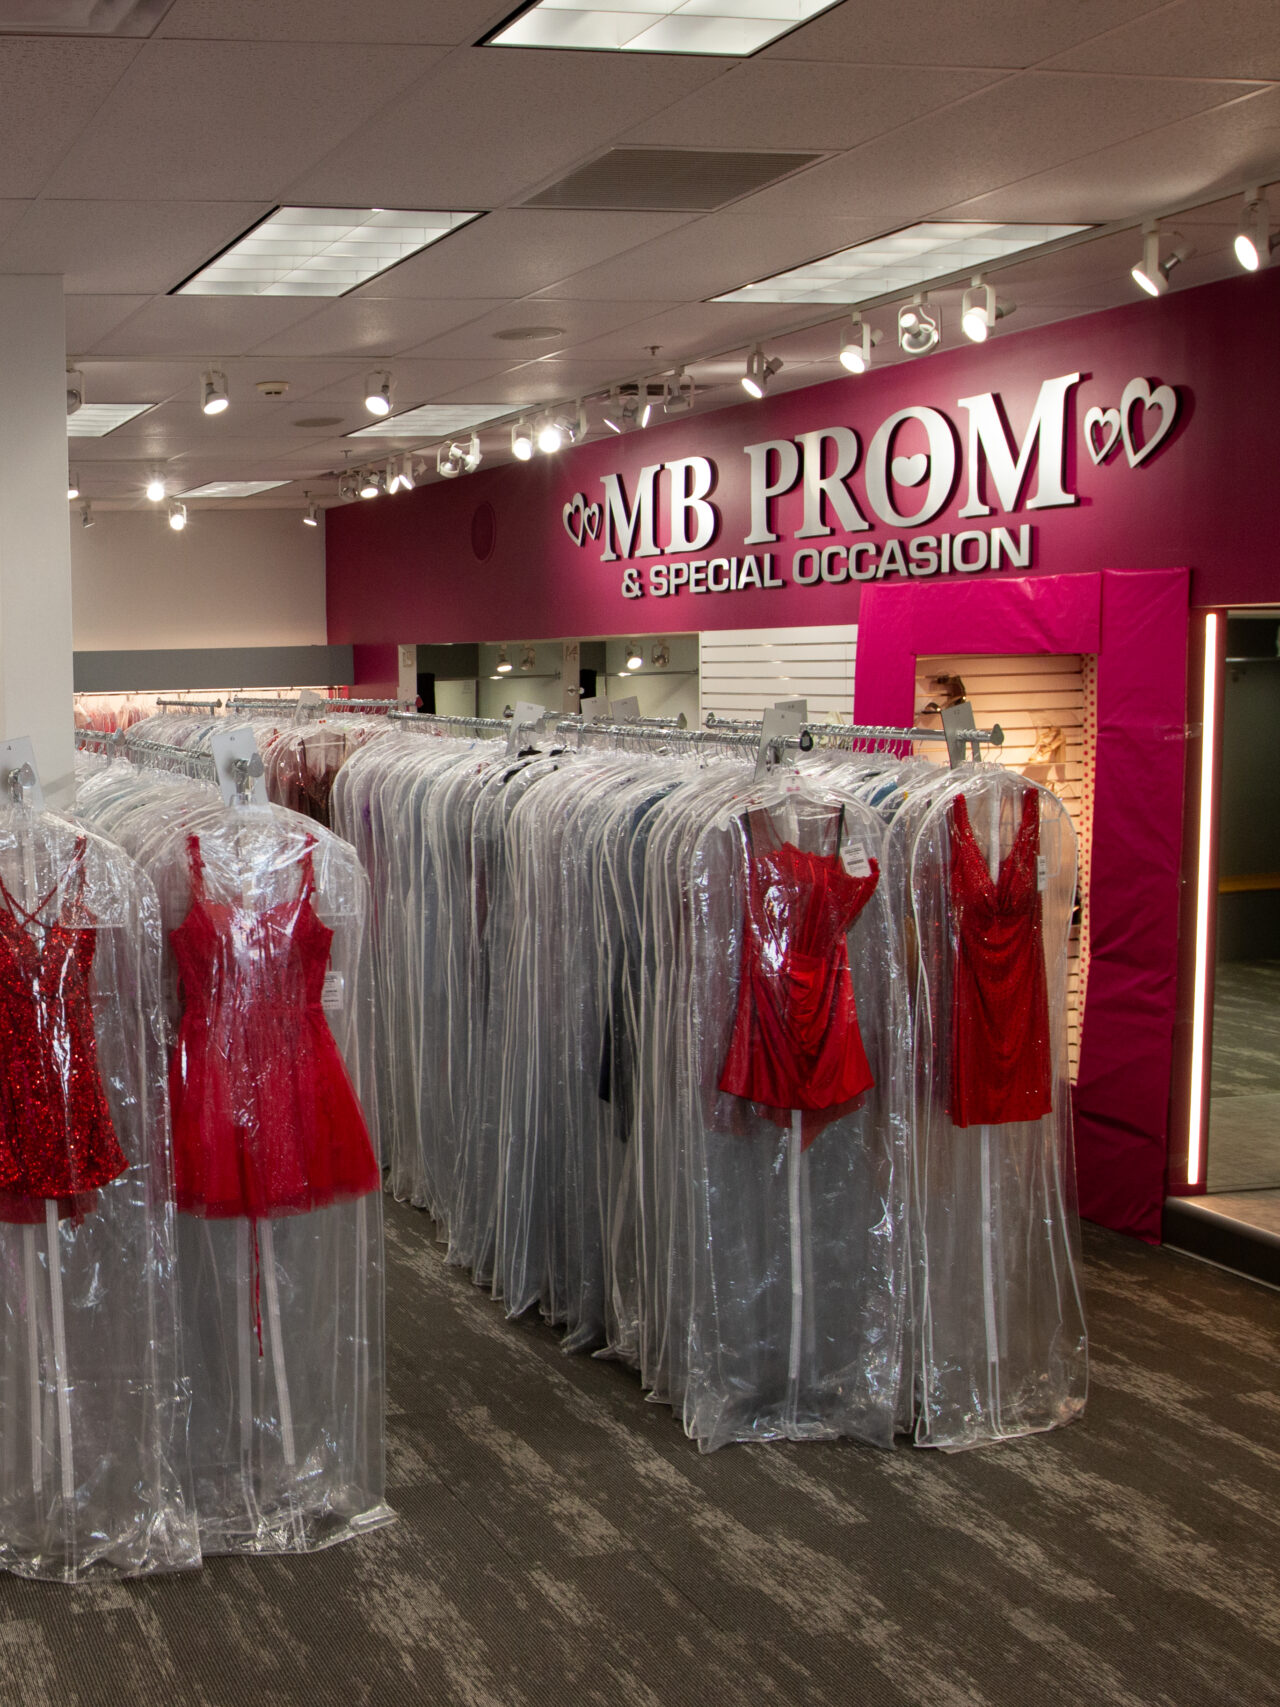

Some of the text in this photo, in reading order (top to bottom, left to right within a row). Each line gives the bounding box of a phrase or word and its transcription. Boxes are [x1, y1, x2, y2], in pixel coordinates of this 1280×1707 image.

[600, 371, 1082, 562] MB PROM
[620, 524, 1032, 598] & SPECIAL OCCASION
